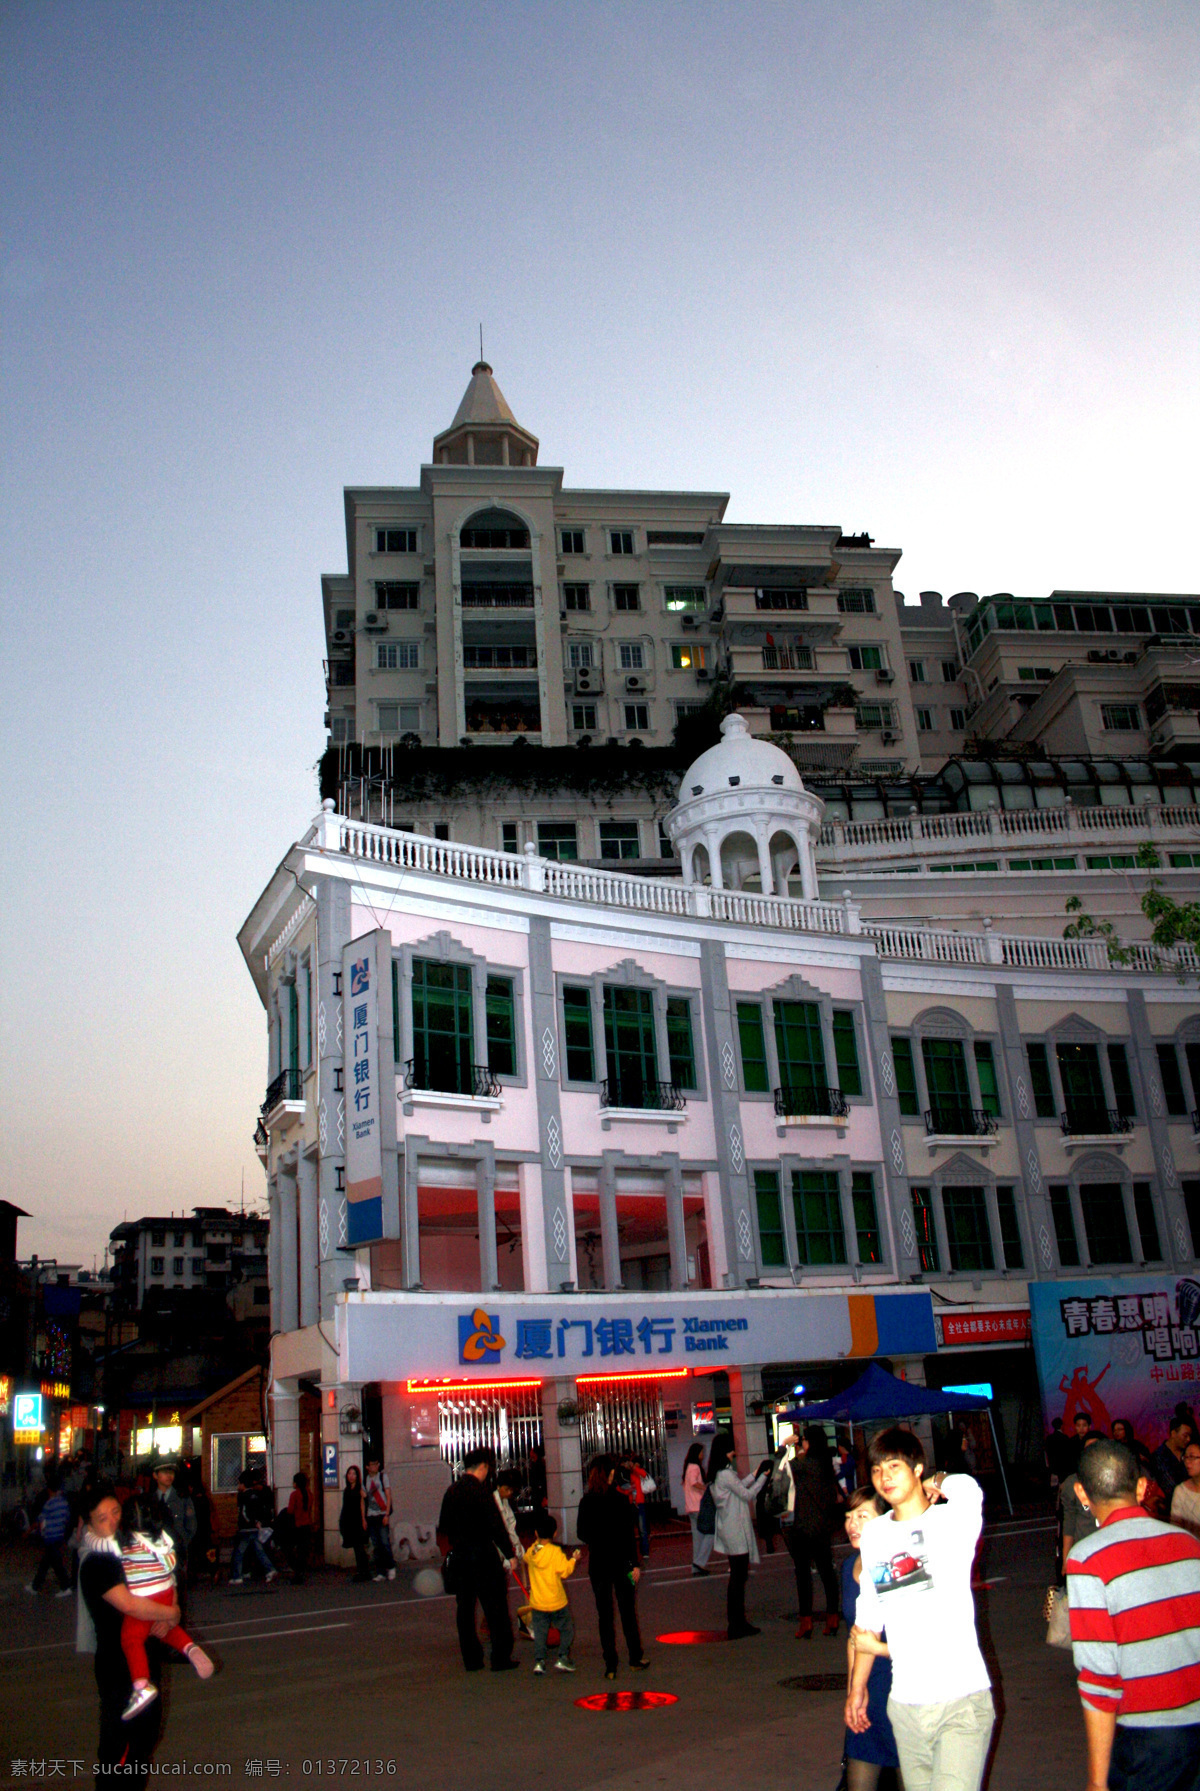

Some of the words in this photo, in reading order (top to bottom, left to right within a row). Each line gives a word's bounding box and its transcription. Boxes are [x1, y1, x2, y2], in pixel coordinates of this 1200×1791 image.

[353, 1003, 371, 1112] 厦门银行
[352, 1118, 374, 1131] Xiamen
[355, 1128, 371, 1139] Bank
[683, 1316, 748, 1333] Xiamen
[514, 1316, 676, 1359] 厦门银行
[684, 1334, 729, 1352] Bank
[1145, 1326, 1200, 1358] 唱响
[17, 1398, 35, 1421] P
[695, 1410, 714, 1422] 110
[325, 1445, 336, 1464] P
